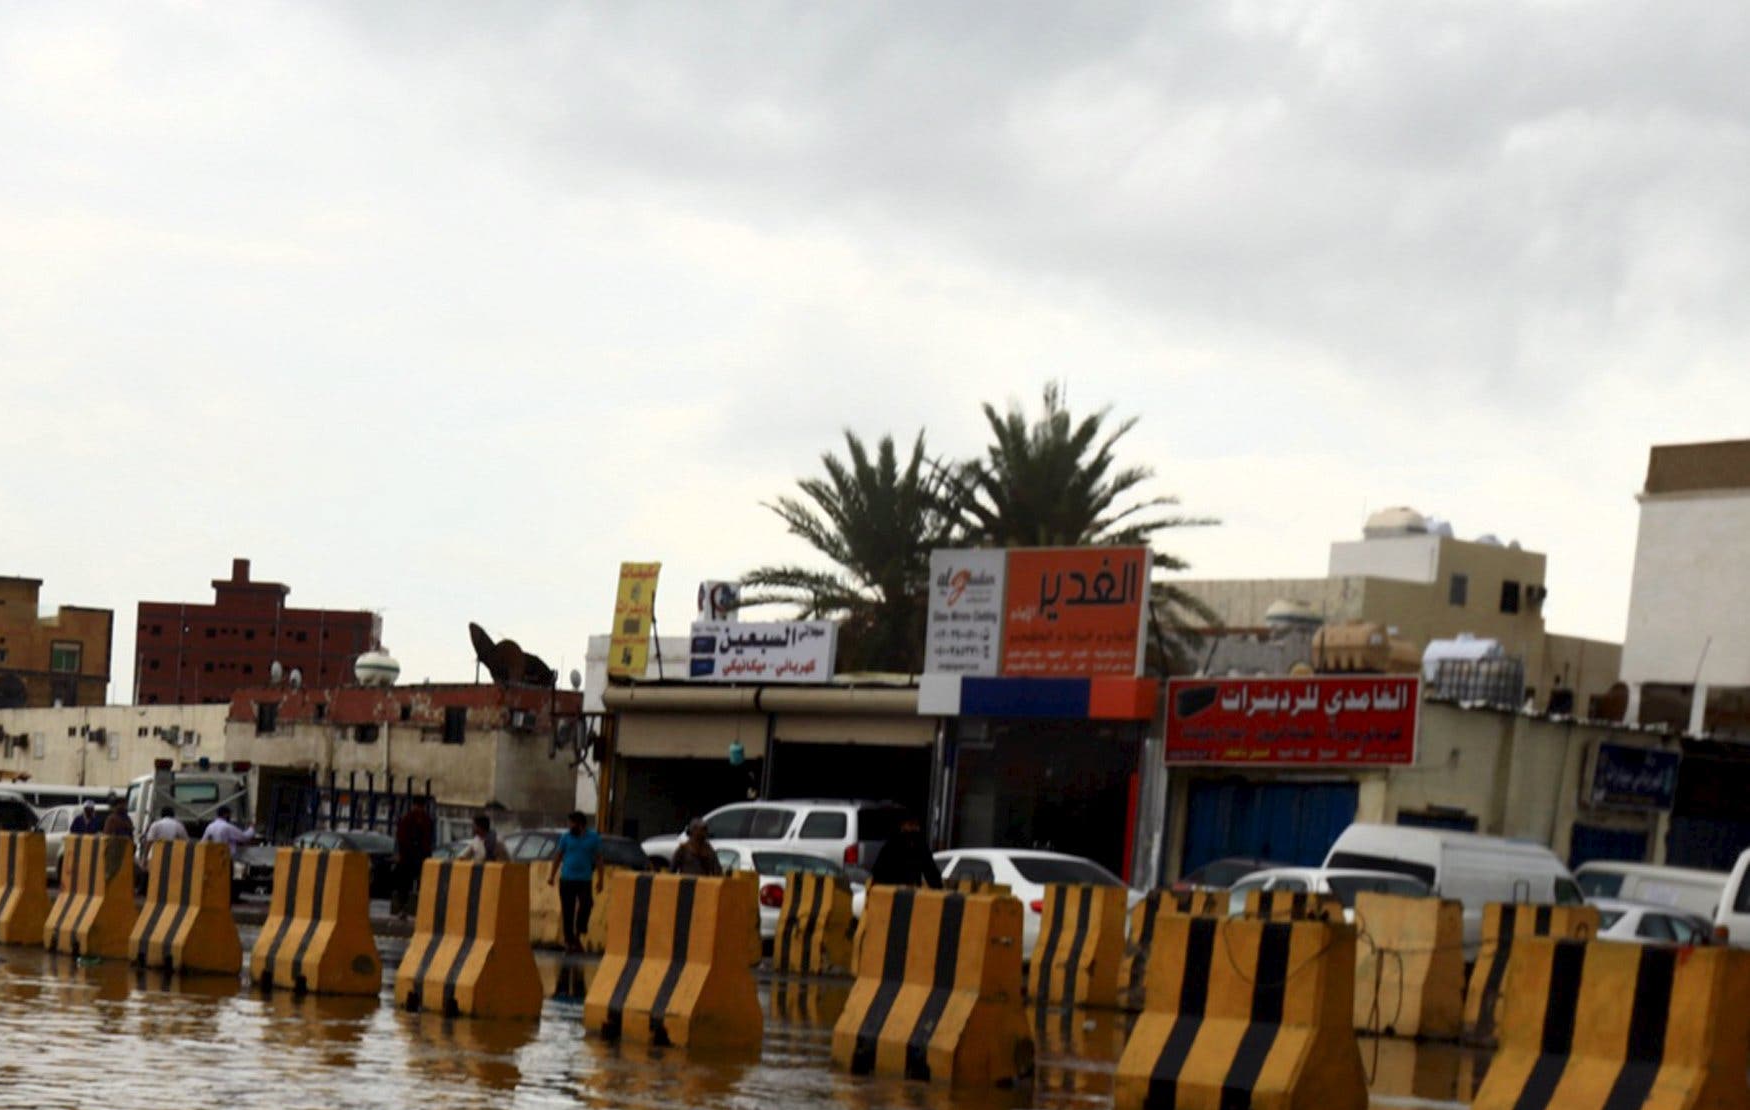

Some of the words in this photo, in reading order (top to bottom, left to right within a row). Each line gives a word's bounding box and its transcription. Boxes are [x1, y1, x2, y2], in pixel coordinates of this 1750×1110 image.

[1038, 556, 1137, 622] الغدير
[719, 626, 797, 654] السبعين
[1324, 684, 1408, 720] الغامدي
